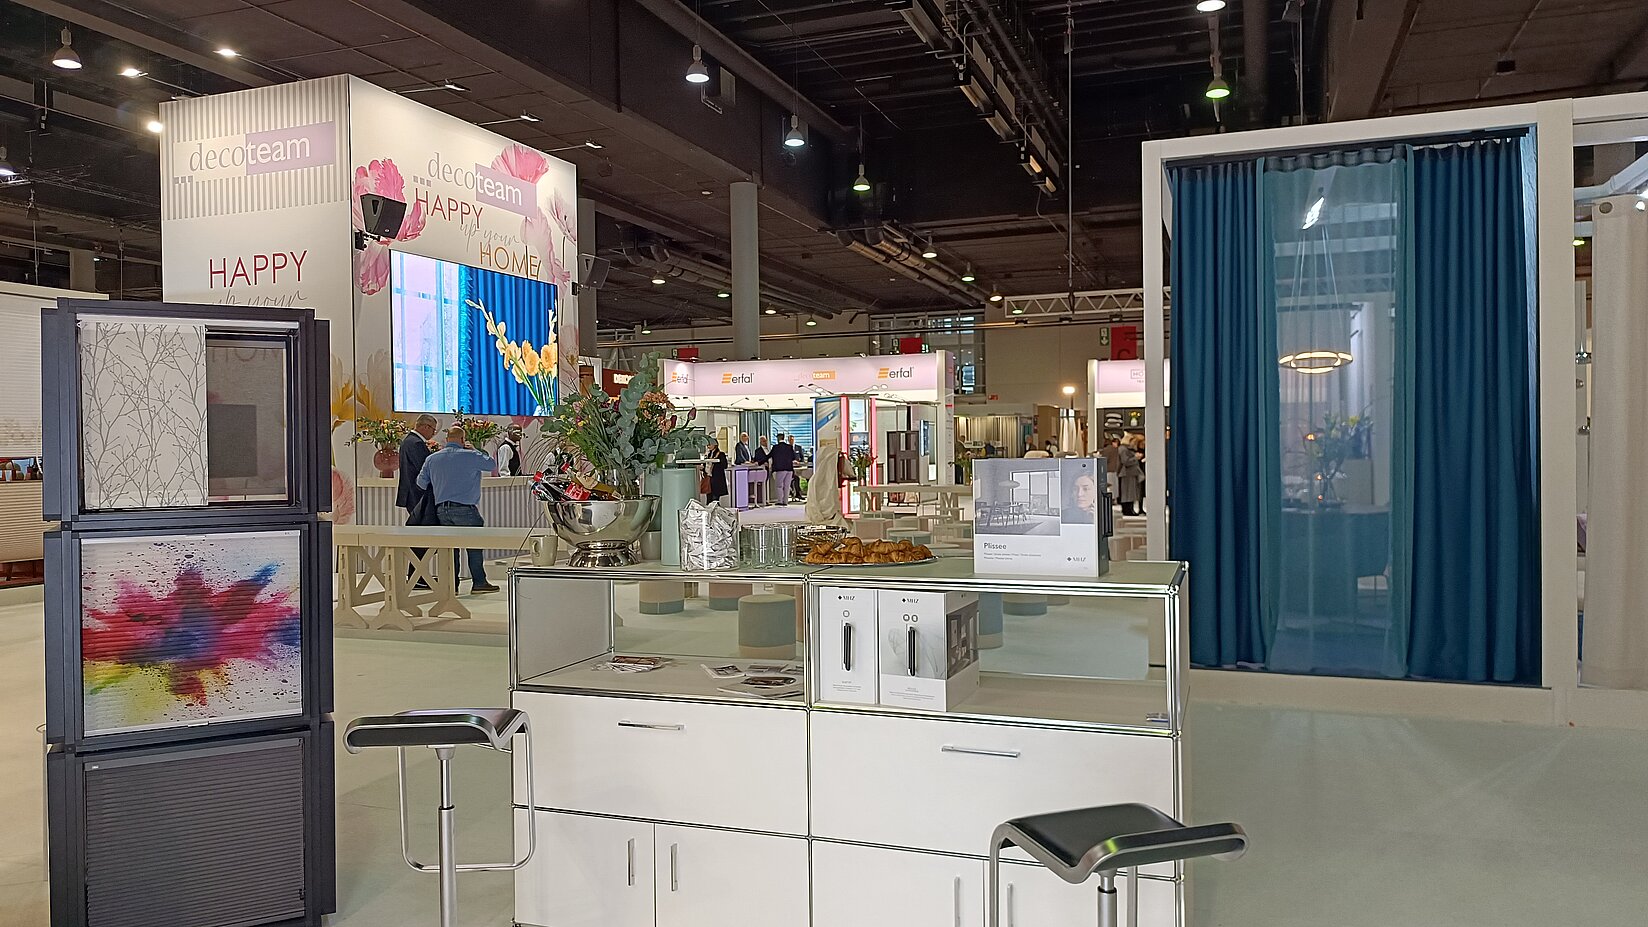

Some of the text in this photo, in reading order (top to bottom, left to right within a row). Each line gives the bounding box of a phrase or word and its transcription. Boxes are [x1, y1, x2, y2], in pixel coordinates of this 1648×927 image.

[189, 136, 310, 172] decoteam
[428, 152, 522, 206] decoteam
[415, 187, 483, 229] HAPPY
[483, 229, 519, 257] your
[208, 250, 308, 289] HAPPY
[983, 542, 1007, 550] Plissee
